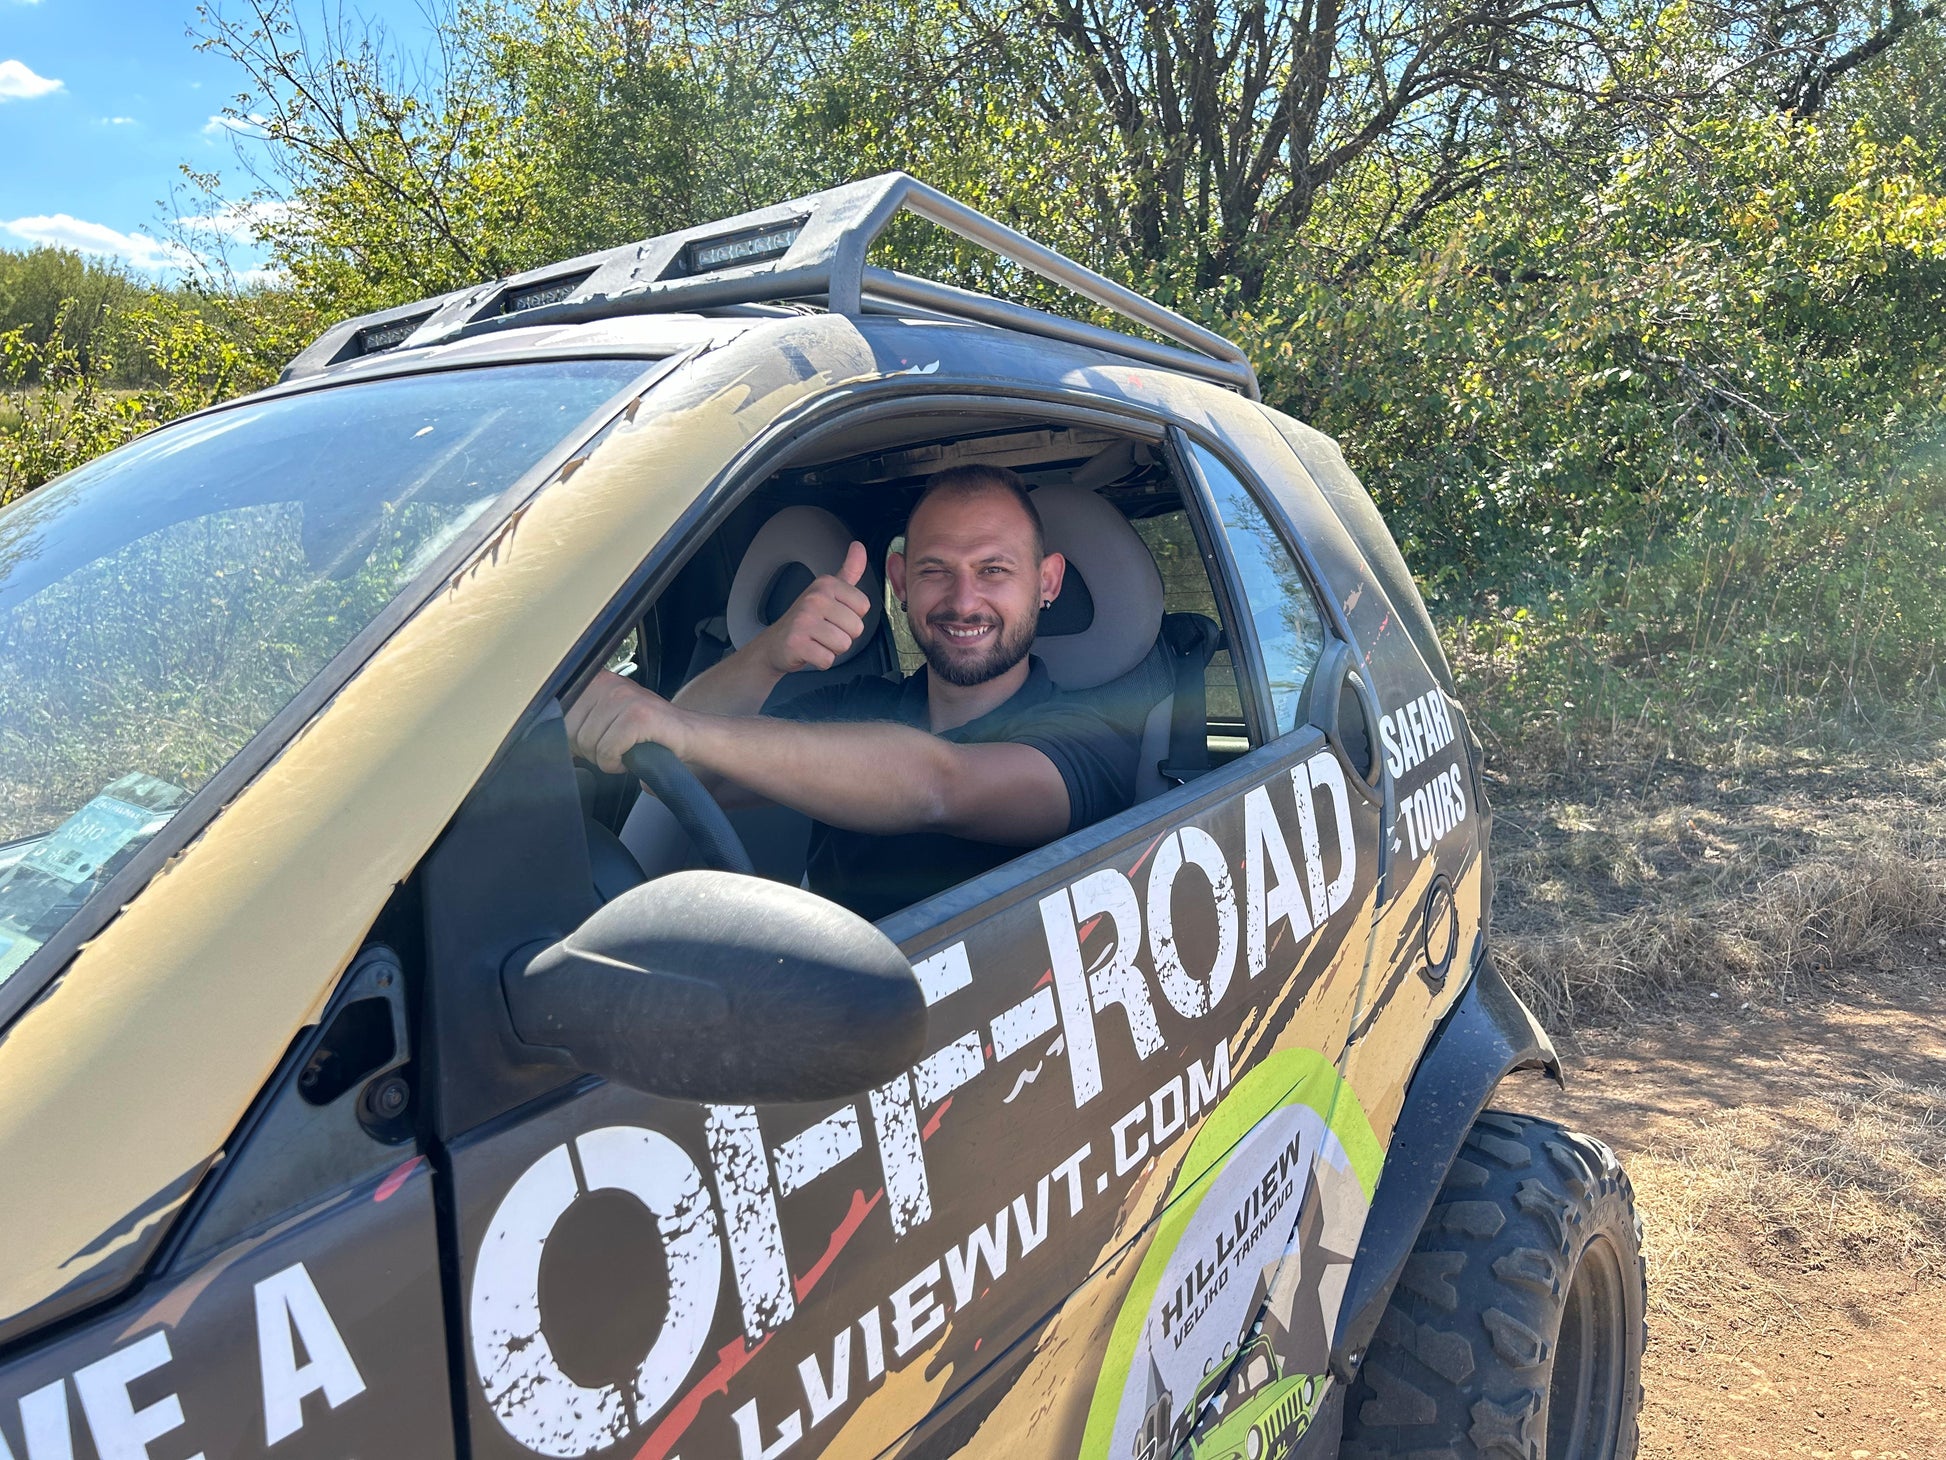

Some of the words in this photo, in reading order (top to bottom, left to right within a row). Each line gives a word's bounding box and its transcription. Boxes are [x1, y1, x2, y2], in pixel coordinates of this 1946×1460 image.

[1379, 686, 1454, 779] SAFARI
[1399, 762, 1466, 860] TOURS
[668, 1037, 1233, 1460] LVIEWVT.COM
[1161, 1130, 1300, 1339] HILLVIEW
[1173, 1267, 1229, 1351] VELIKO
[1233, 1179, 1293, 1267] TARNOVO
[254, 1261, 367, 1447] A
